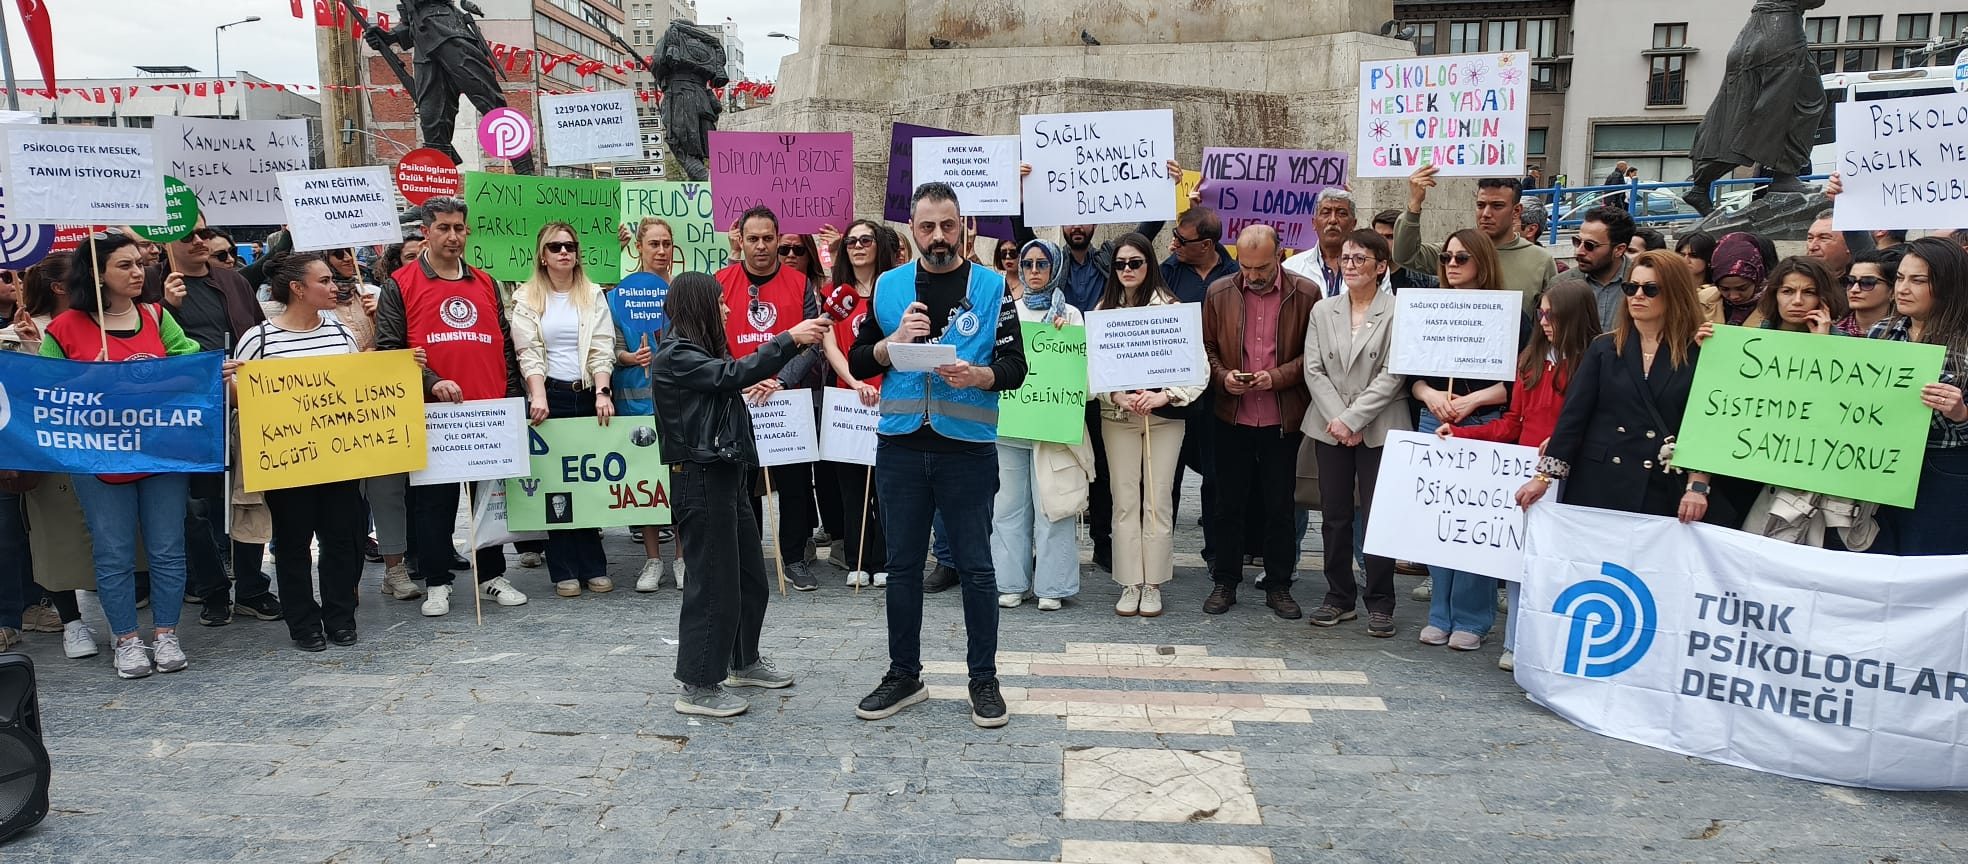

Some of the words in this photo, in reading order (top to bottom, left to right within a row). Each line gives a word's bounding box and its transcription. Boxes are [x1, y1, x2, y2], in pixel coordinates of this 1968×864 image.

[1371, 63, 1458, 90] PSİKOLOG
[554, 104, 590, 115] 1219'DA
[591, 101, 622, 112] YOKUZ,
[1370, 92, 1440, 115] MESLEK
[1449, 87, 1515, 112] YASASI
[557, 118, 593, 129] SAHADA
[595, 115, 623, 126] VARIZ!
[1869, 104, 1968, 140] PSİKOLO
[182, 123, 256, 151] KANUNLAR
[267, 131, 304, 149] AÇIK:
[1034, 120, 1101, 149] SAĞLIK
[23, 143, 75, 153] PSİKOLOG
[77, 145, 96, 154] TEK
[99, 146, 141, 156] MESLEK,
[968, 146, 985, 154] VAR,
[1075, 138, 1155, 165] BAKANLIĞI
[1372, 139, 1517, 167] GÜVENCESİDİR
[1845, 148, 1922, 177] SAĞLIK
[1939, 142, 1967, 163] ME
[172, 160, 232, 178] MESLEK
[249, 157, 308, 174] LİSANSLA
[400, 162, 457, 174] Psikologların
[717, 148, 786, 175] DİPLOMA
[798, 147, 845, 174] BİZDE
[942, 157, 972, 166] KARŞILIK
[973, 157, 990, 165] YOK!
[1203, 152, 1278, 182] MESLEK
[1288, 155, 1346, 186] YASASI
[28, 166, 71, 177] TANIM
[74, 166, 141, 179] İSTİYORUZ!
[304, 180, 329, 190] AYNI
[331, 176, 370, 188] EĞİTİM,
[398, 172, 424, 183] Özlük
[425, 174, 458, 185] Hakları
[943, 168, 960, 176] ADİL
[961, 168, 989, 177] ÖDEME,
[402, 183, 455, 195] Düzenlensin
[475, 181, 523, 207] AYNI
[536, 183, 621, 209] SORUMLULUK
[770, 176, 812, 193] AMA
[965, 180, 998, 189] ÇALIŞMA!
[90, 201, 130, 209] LİSANSİYER
[294, 196, 330, 207] FARKLI
[332, 192, 384, 205] MUAMELE,
[627, 189, 688, 218] FREUD
[780, 187, 852, 221] NEREDE?
[1077, 190, 1147, 215] BURADA
[1218, 187, 1239, 211] IS
[1252, 189, 1318, 215] LOADIN
[324, 209, 364, 221] OLMAZ!
[477, 216, 528, 237] FARKLI
[473, 245, 494, 270] BU
[630, 309, 662, 320] İstiyor
[1409, 302, 1439, 310] SAĞLIKÇI
[1440, 301, 1471, 310] DEĞİLSİN
[1472, 302, 1504, 311] DEDİLER,
[1104, 328, 1150, 339] PSİKOLOGLAR
[1151, 327, 1182, 335] BURADA!
[1106, 319, 1149, 328] GÖRMEZDEN
[1150, 316, 1179, 325] GELİNEN
[1099, 341, 1125, 350] MESLEK
[1126, 339, 1151, 348] TANIMI
[1152, 337, 1189, 347] İSTİYORUZ,
[1446, 335, 1486, 344] İSTİYORUZ!
[1116, 351, 1150, 360] OYALAMA
[1150, 349, 1173, 357] DEĞİL!
[1739, 338, 1915, 388] SAHADAYIZ
[248, 370, 336, 397] MİLYONLUK
[33, 386, 105, 406] TÜRK
[292, 391, 347, 414] YÜKSEK
[354, 382, 407, 404] LİSANS
[1020, 383, 1085, 407] GELİNİYOR
[33, 405, 204, 427] PSİKOLOGLAR
[450, 409, 506, 418] LİSANSİYERİNİN
[1704, 389, 1814, 420] SİSTEMDE
[1838, 400, 1884, 427] YOK
[260, 424, 303, 447] KAMU
[310, 404, 397, 432] ATAMASININ
[425, 422, 463, 430] BİTMEYEN
[464, 420, 486, 430] ÇİLESİ
[832, 421, 855, 430] KABUL
[35, 428, 142, 451] DERNEĞİ
[431, 443, 472, 452] MÜCADELE
[473, 442, 501, 450] ORTAK!
[444, 432, 459, 441] ÇİLE
[460, 432, 488, 440] ORTAK,
[259, 440, 319, 472] ÖLÇÜTÜ
[1399, 440, 1478, 471] TAYYİP
[1731, 428, 1902, 474] SAYILIYORUZ
[561, 451, 627, 483] EGO
[608, 479, 670, 509] YASA
[1437, 510, 1524, 551] ÜZGÜN
[1694, 591, 1796, 635] TÜRK
[1680, 667, 1854, 728] DERNEĞİ
